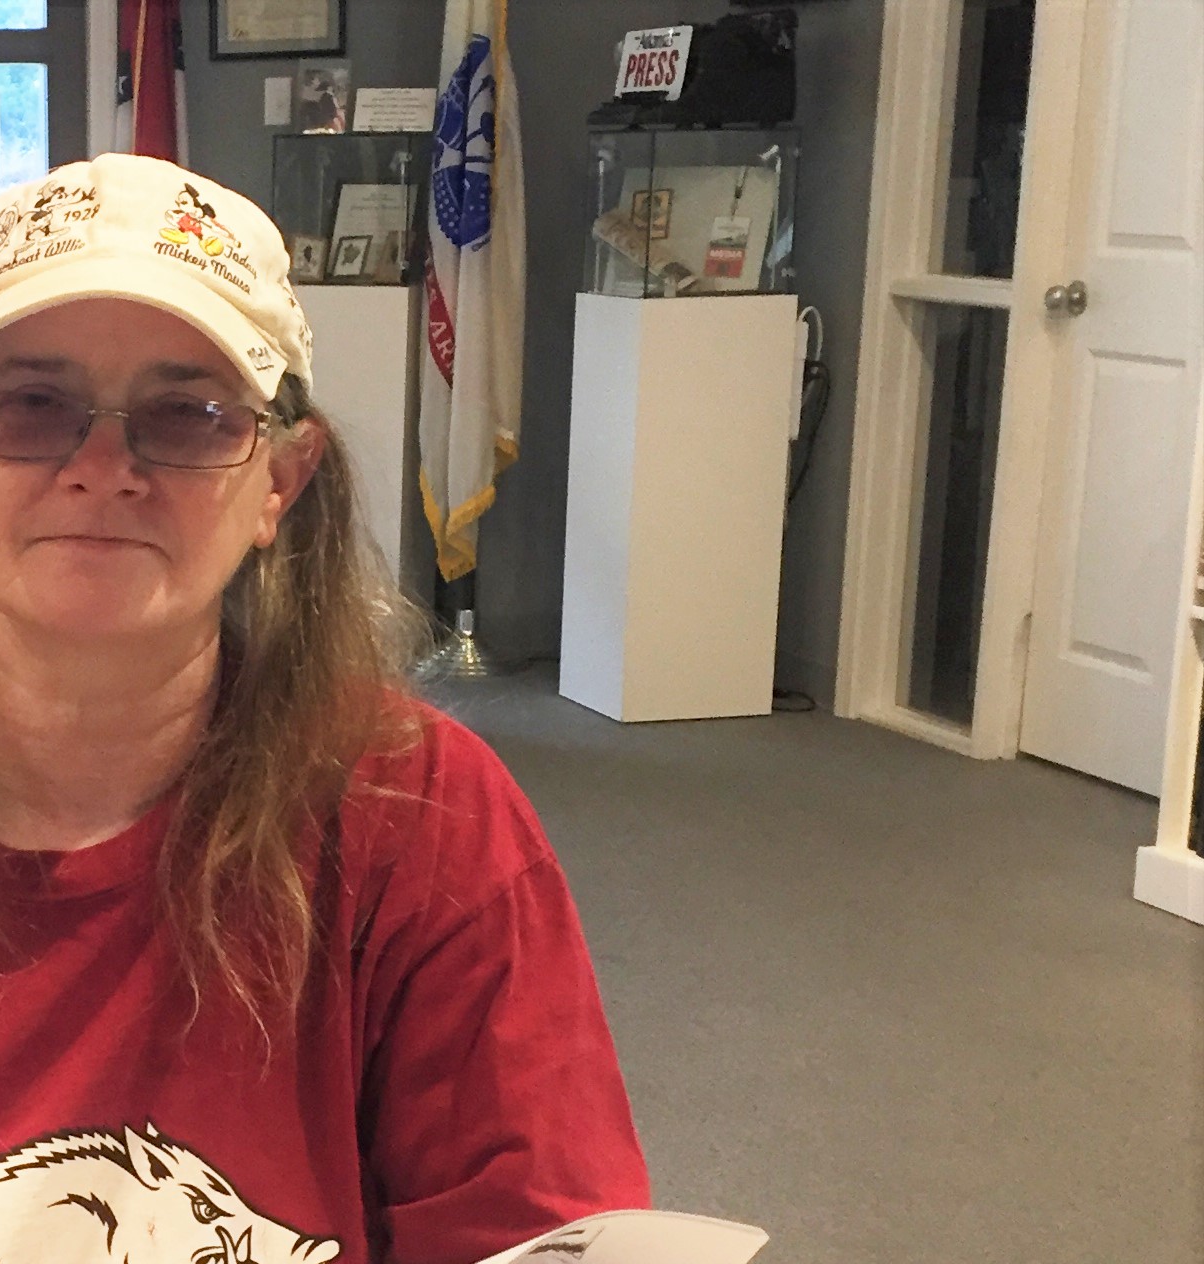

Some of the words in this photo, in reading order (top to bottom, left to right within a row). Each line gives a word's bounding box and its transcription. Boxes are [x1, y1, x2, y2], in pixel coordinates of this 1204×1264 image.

[623, 49, 680, 88] PRESS
[63, 204, 101, 223] 1928
[44, 239, 86, 259] Willie
[223, 244, 258, 280] Today
[153, 241, 208, 271] Mickey
[211, 259, 251, 295] Mouse
